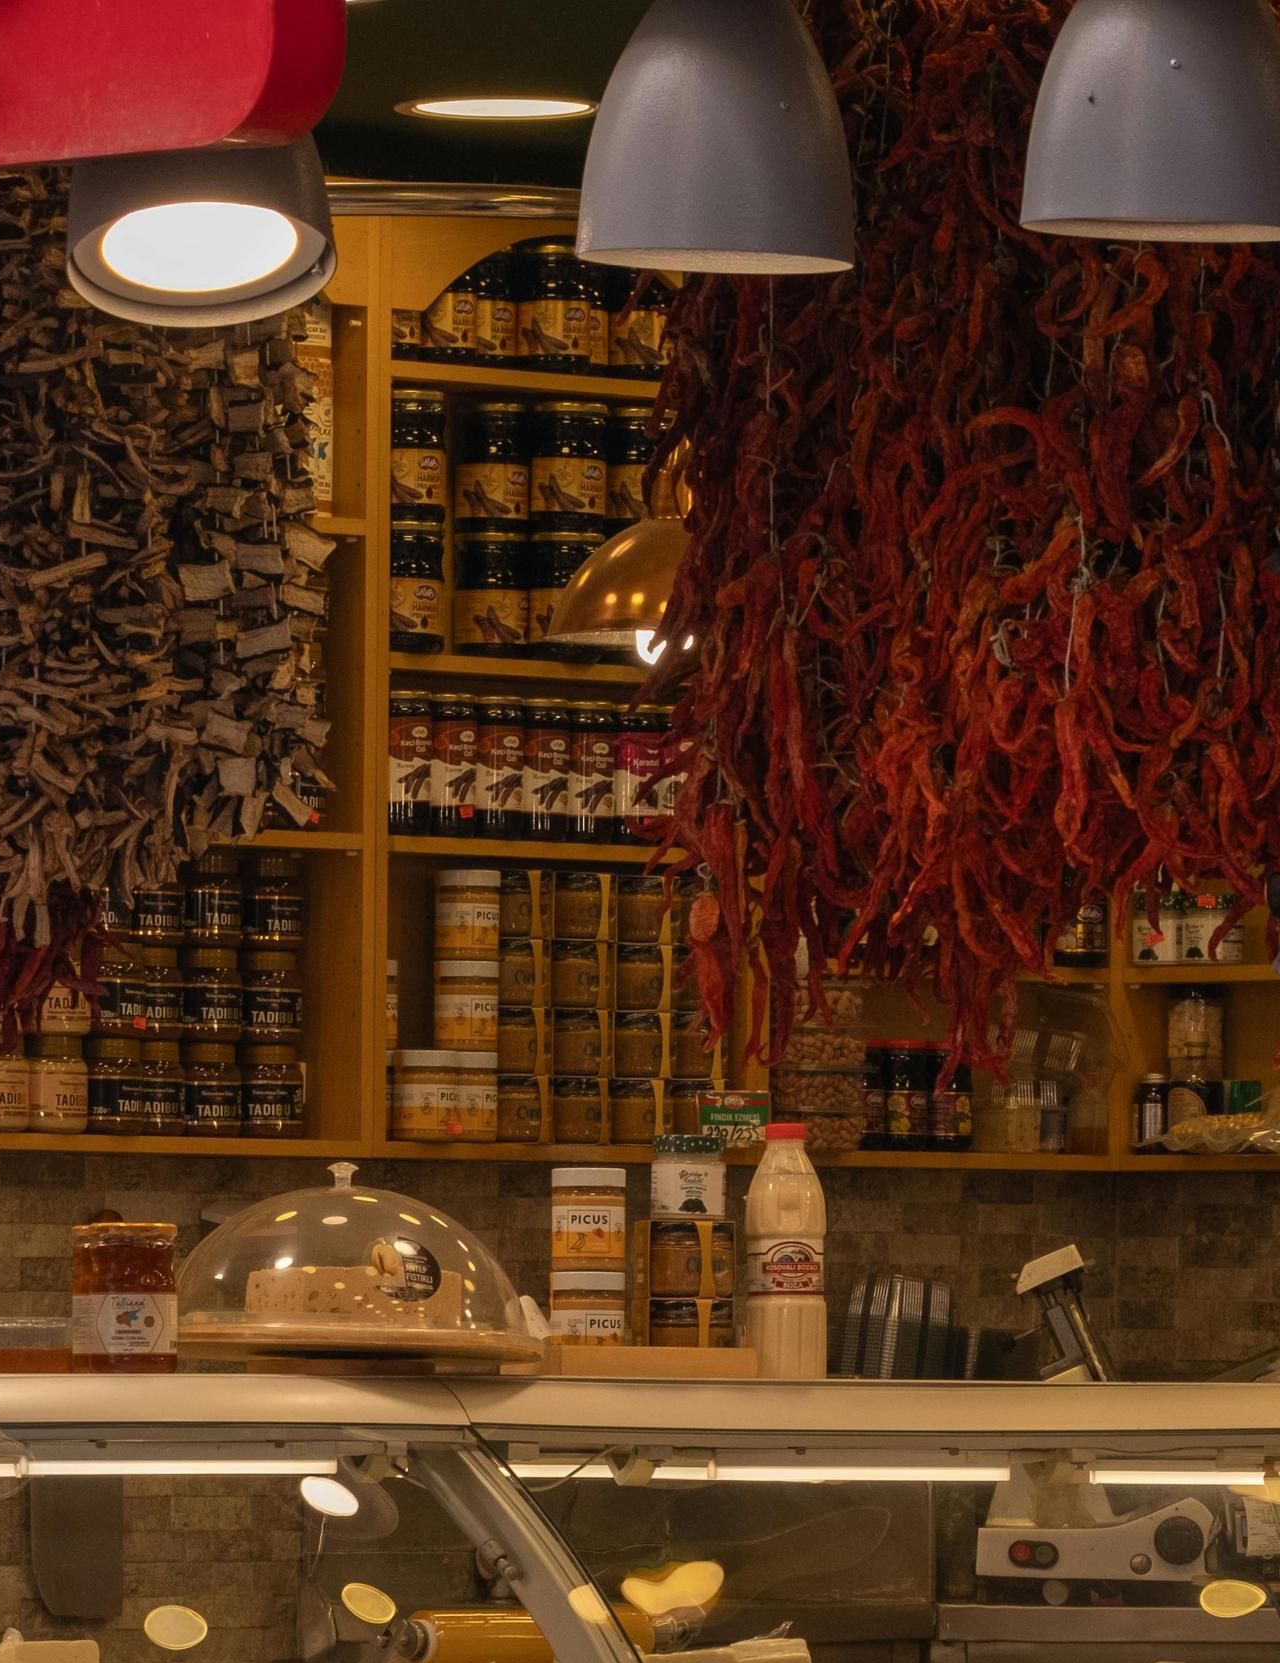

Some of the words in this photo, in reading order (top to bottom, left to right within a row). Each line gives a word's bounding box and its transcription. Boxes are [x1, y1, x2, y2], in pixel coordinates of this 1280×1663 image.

[476, 911, 499, 921] PICU
[251, 1010, 294, 1024] TADIBU
[248, 1102, 292, 1116] TADIBU
[570, 1214, 609, 1225] PICUS
[589, 1318, 622, 1329] PICUS
